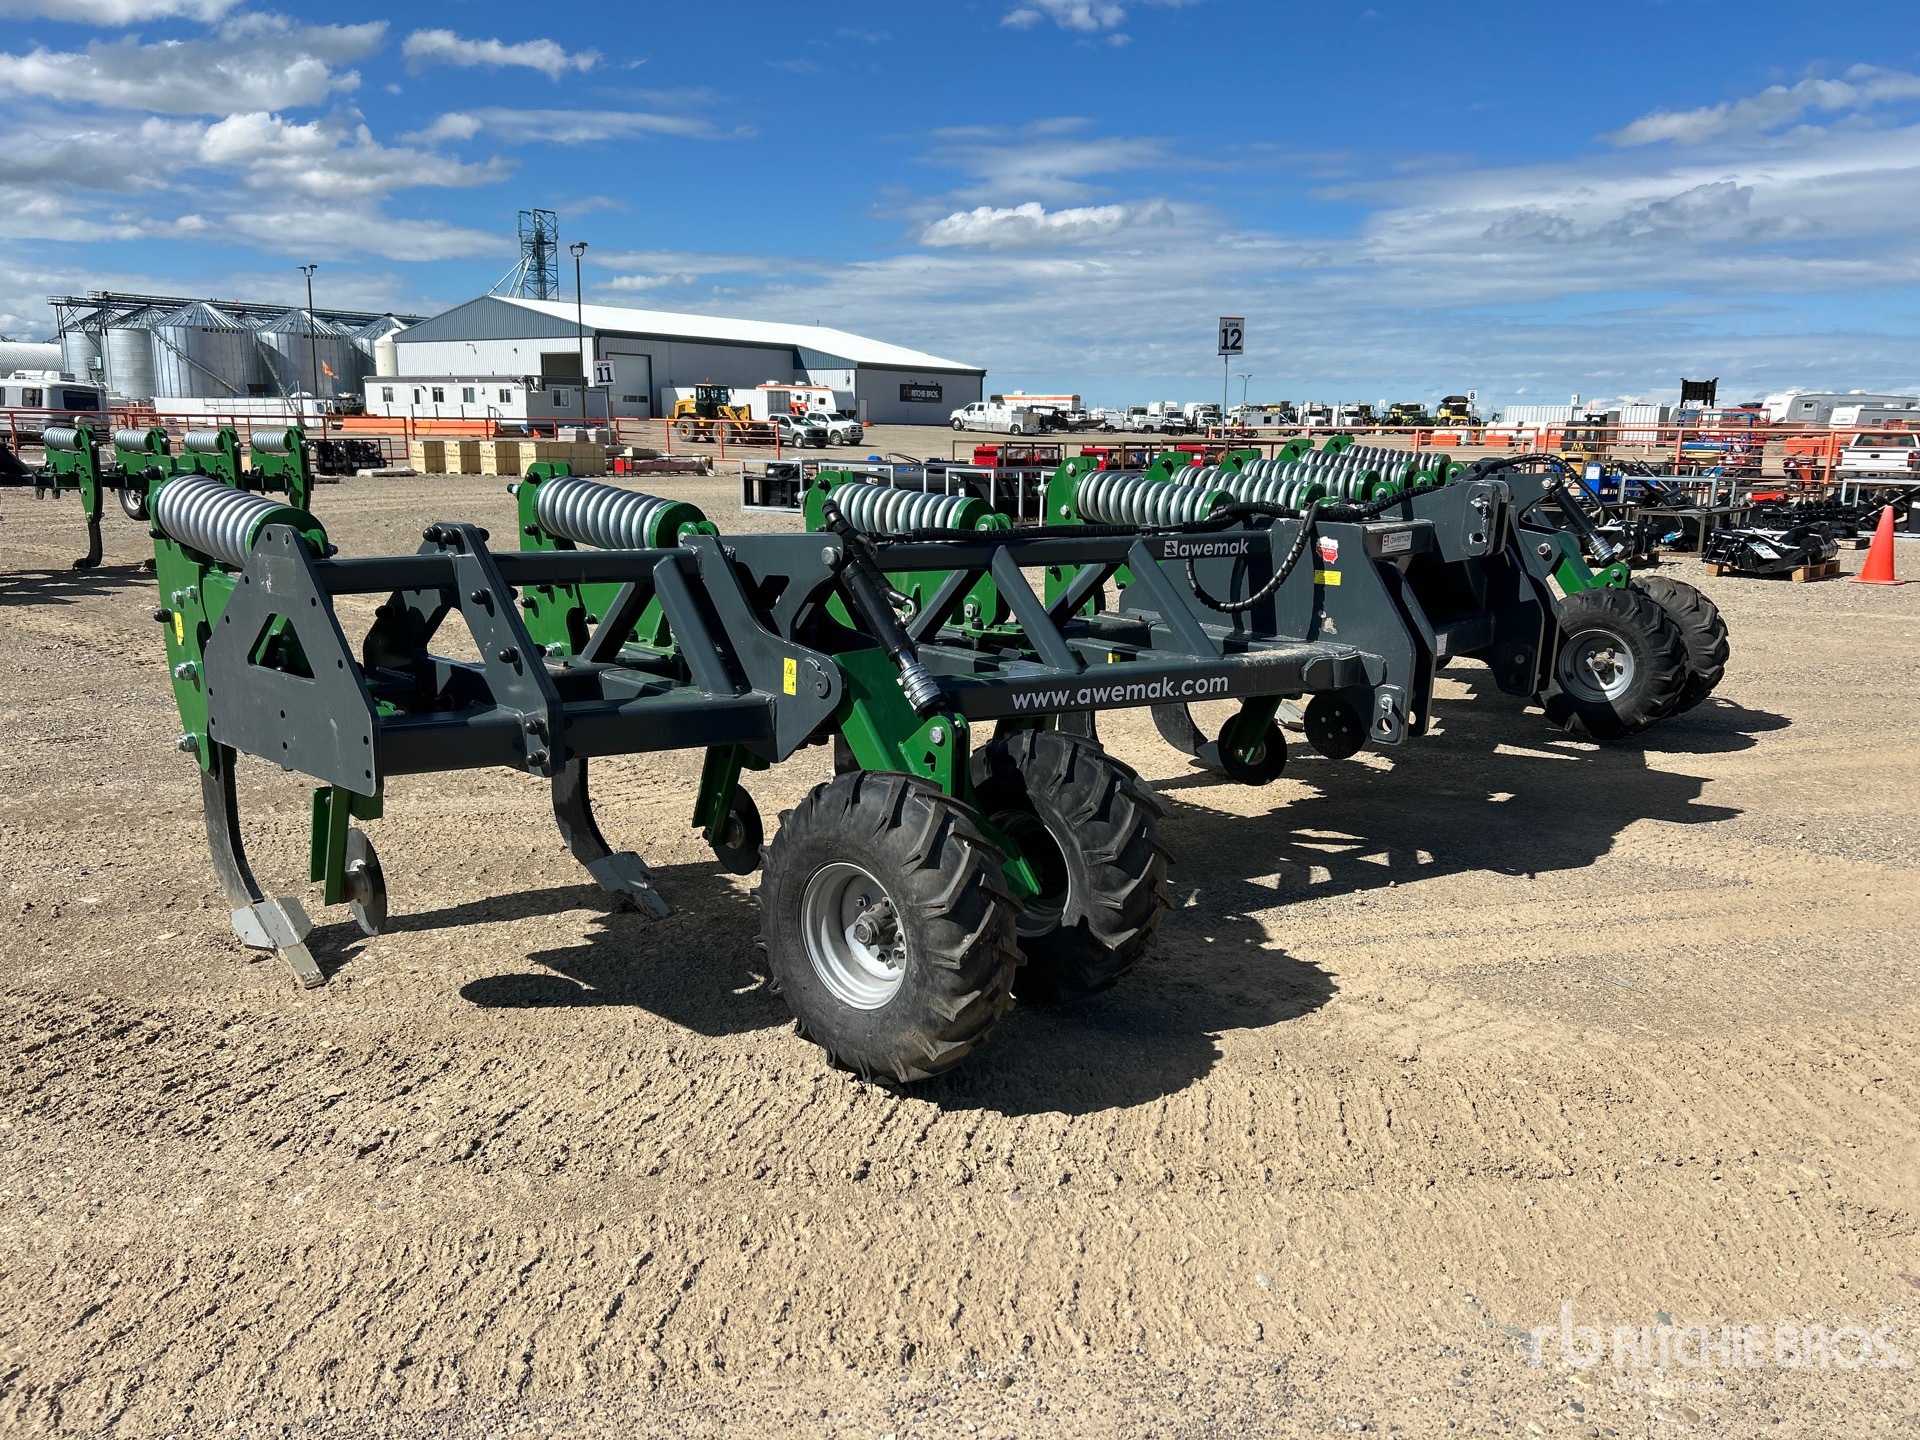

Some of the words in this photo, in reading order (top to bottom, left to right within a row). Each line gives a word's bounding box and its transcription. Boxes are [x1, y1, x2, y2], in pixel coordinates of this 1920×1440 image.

[1221, 328, 1242, 350] 12
[596, 367, 613, 383] 11
[1179, 538, 1250, 557] awemak
[1011, 676, 1229, 710] www.awemak.com
